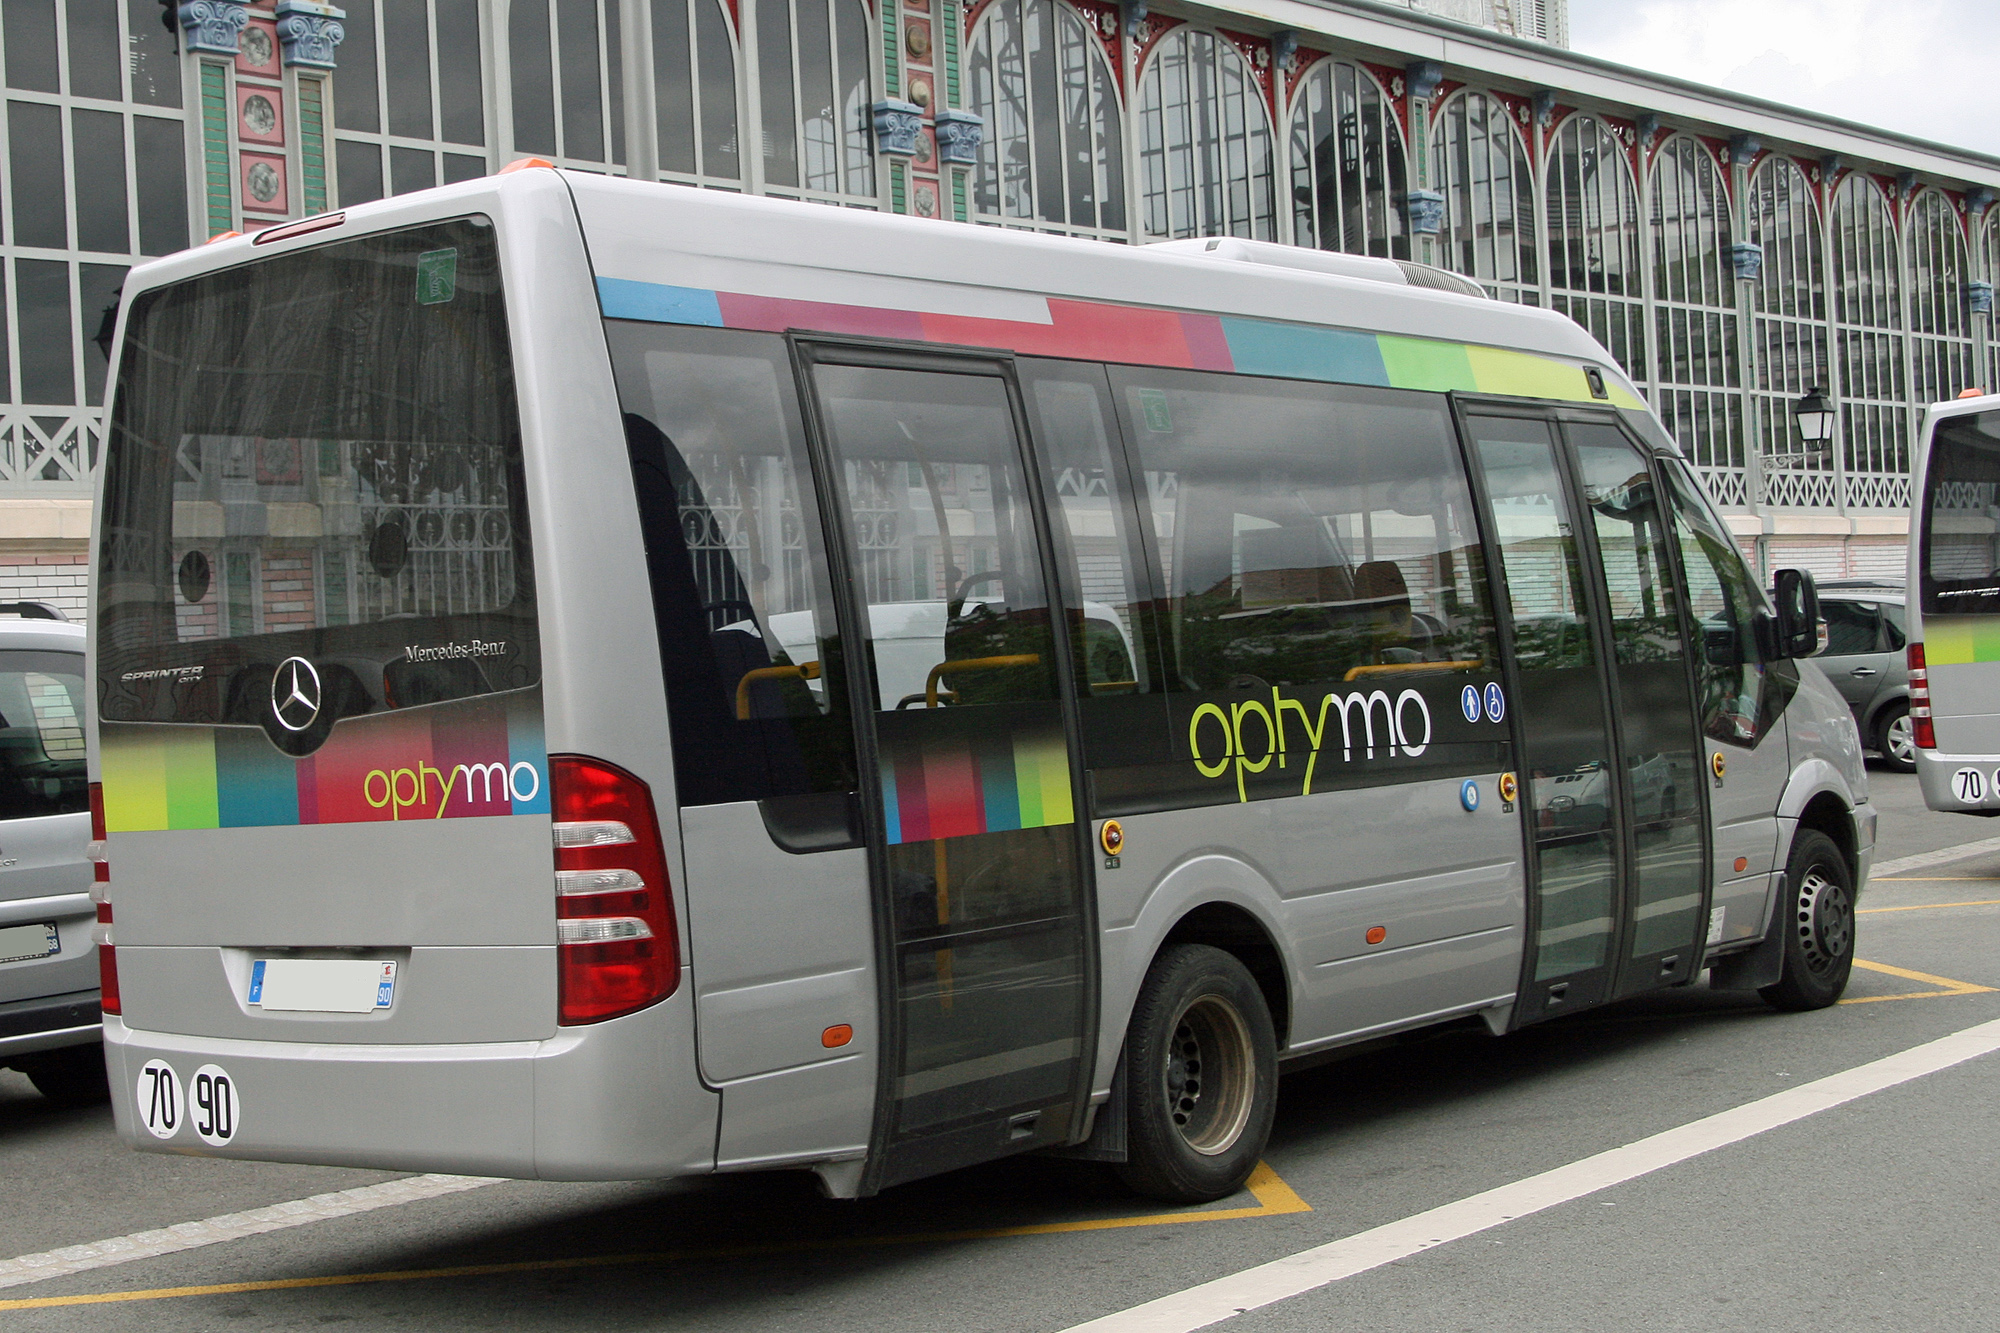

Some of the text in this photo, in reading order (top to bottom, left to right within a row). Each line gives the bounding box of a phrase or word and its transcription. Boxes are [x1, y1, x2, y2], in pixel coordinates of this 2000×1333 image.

[405, 639, 507, 663] Mercedes-Benz
[120, 665, 205, 682] SPRINTER
[1189, 686, 1431, 803] optymo
[363, 760, 539, 820] optymo
[1957, 771, 1982, 800] 70
[252, 985, 260, 996] F
[378, 987, 390, 1002] 90
[145, 1067, 176, 1130] 70
[196, 1073, 232, 1139] 90
